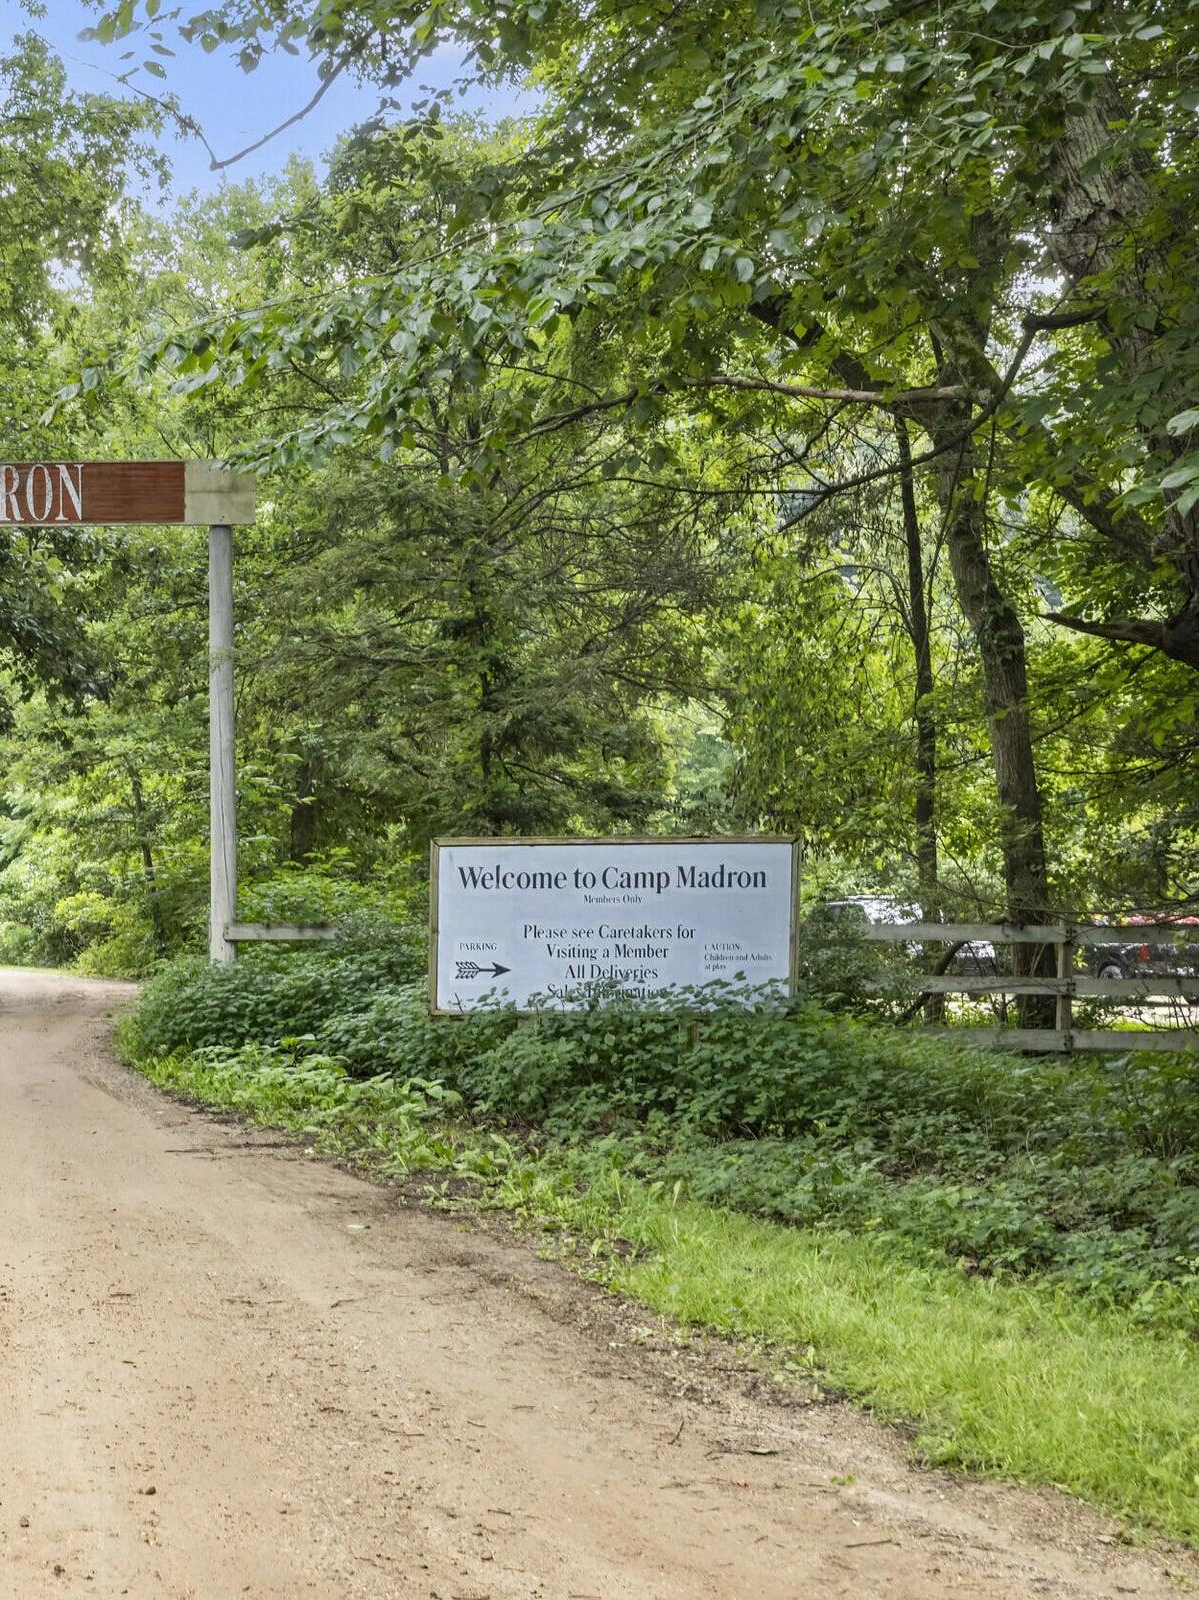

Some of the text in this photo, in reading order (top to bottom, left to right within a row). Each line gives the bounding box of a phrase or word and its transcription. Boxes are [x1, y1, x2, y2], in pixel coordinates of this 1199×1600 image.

[458, 863, 767, 895] Welcome to Camp Madron
[583, 893, 643, 905] Members Only
[523, 923, 697, 940] Please see Caretakers for
[459, 942, 498, 951] PARKING
[546, 943, 669, 961] Visiting a Member
[704, 953, 734, 961] Children
[735, 953, 748, 961] and
[564, 963, 660, 980] All Deliveries
[712, 962, 727, 972] play
[546, 983, 584, 1000] Sals
